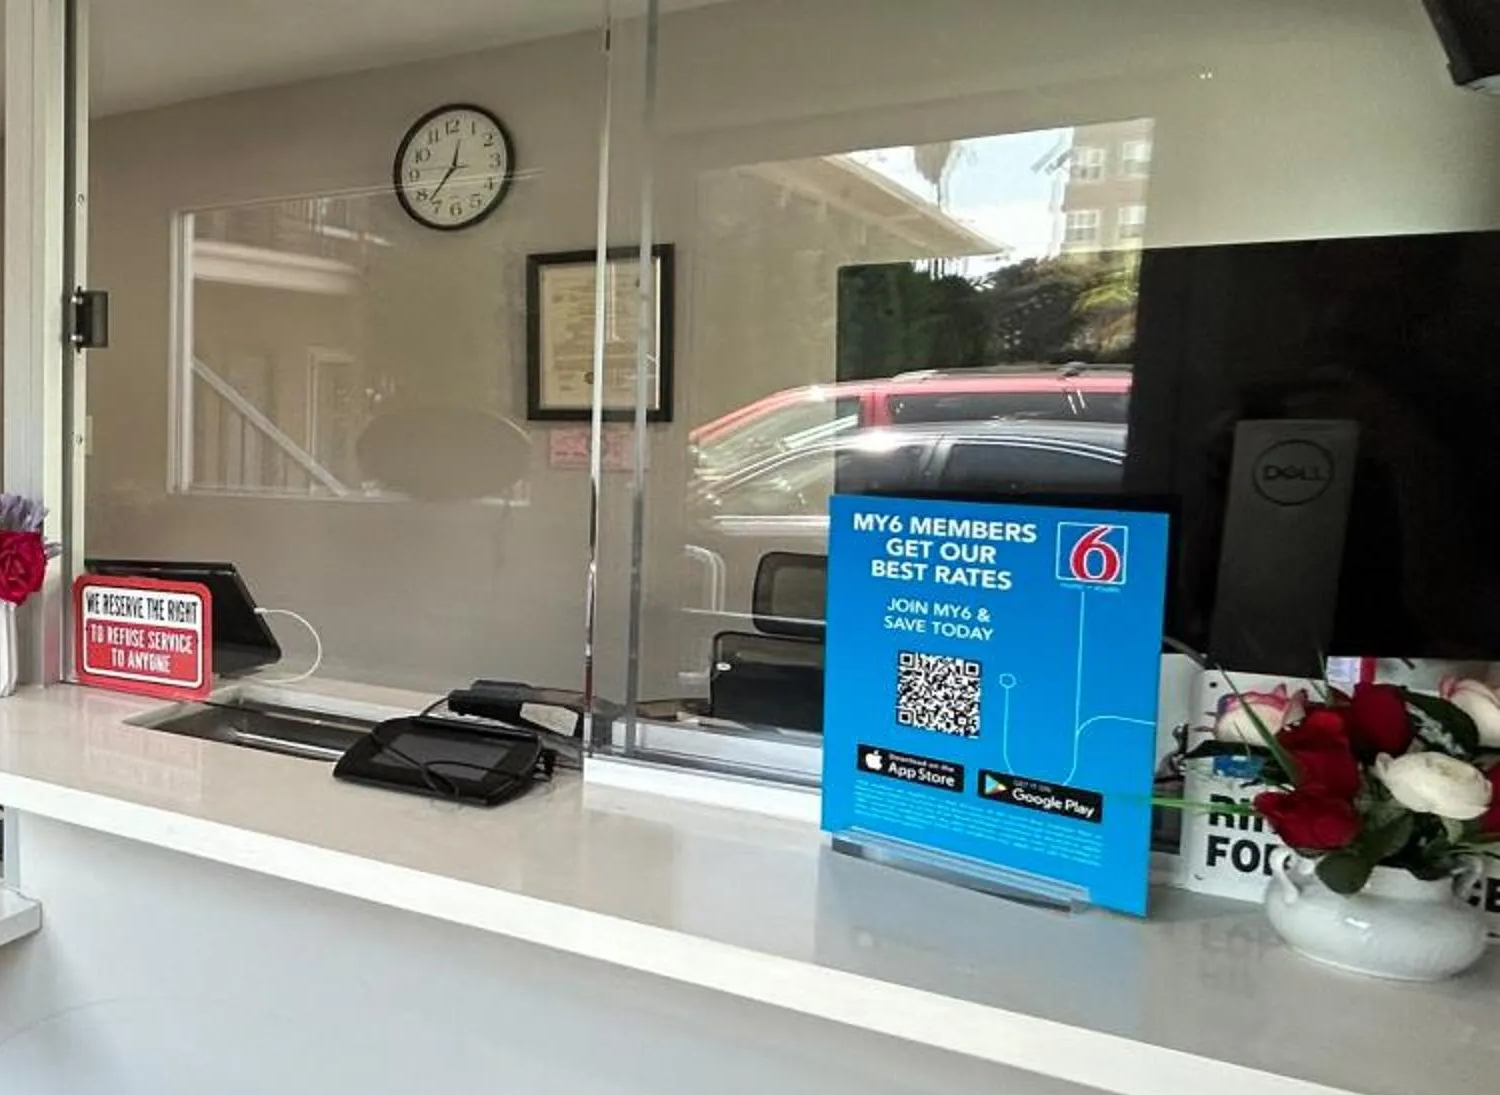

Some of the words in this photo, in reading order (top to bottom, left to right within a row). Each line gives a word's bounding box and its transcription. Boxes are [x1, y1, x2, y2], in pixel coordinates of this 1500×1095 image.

[446, 120, 460, 135] 12
[1264, 464, 1325, 481] DELL
[853, 512, 902, 533] MY6
[910, 516, 1037, 543] MEMBERS
[886, 538, 933, 558] GET
[940, 542, 997, 564] OUR
[1069, 524, 1121, 582] 6
[871, 559, 928, 581] BEST
[935, 565, 1013, 590] RATES
[86, 592, 100, 614] WE
[102, 594, 143, 619] RESERVE
[146, 597, 164, 621] THE
[168, 600, 198, 624] RIGHT
[887, 598, 928, 615] JOIN
[933, 603, 972, 620] MY6
[977, 608, 991, 622] &
[91, 624, 103, 643] TO
[107, 625, 145, 647] REFUSE
[149, 631, 193, 654] SERVICE
[884, 615, 926, 632] SAVE
[932, 621, 993, 641] TODAY
[111, 647, 124, 666] TO
[127, 650, 171, 673] ANYONE
[888, 761, 917, 780] App
[918, 767, 956, 787] Store
[1012, 787, 1062, 810] Google
[1065, 799, 1095, 818] Play
